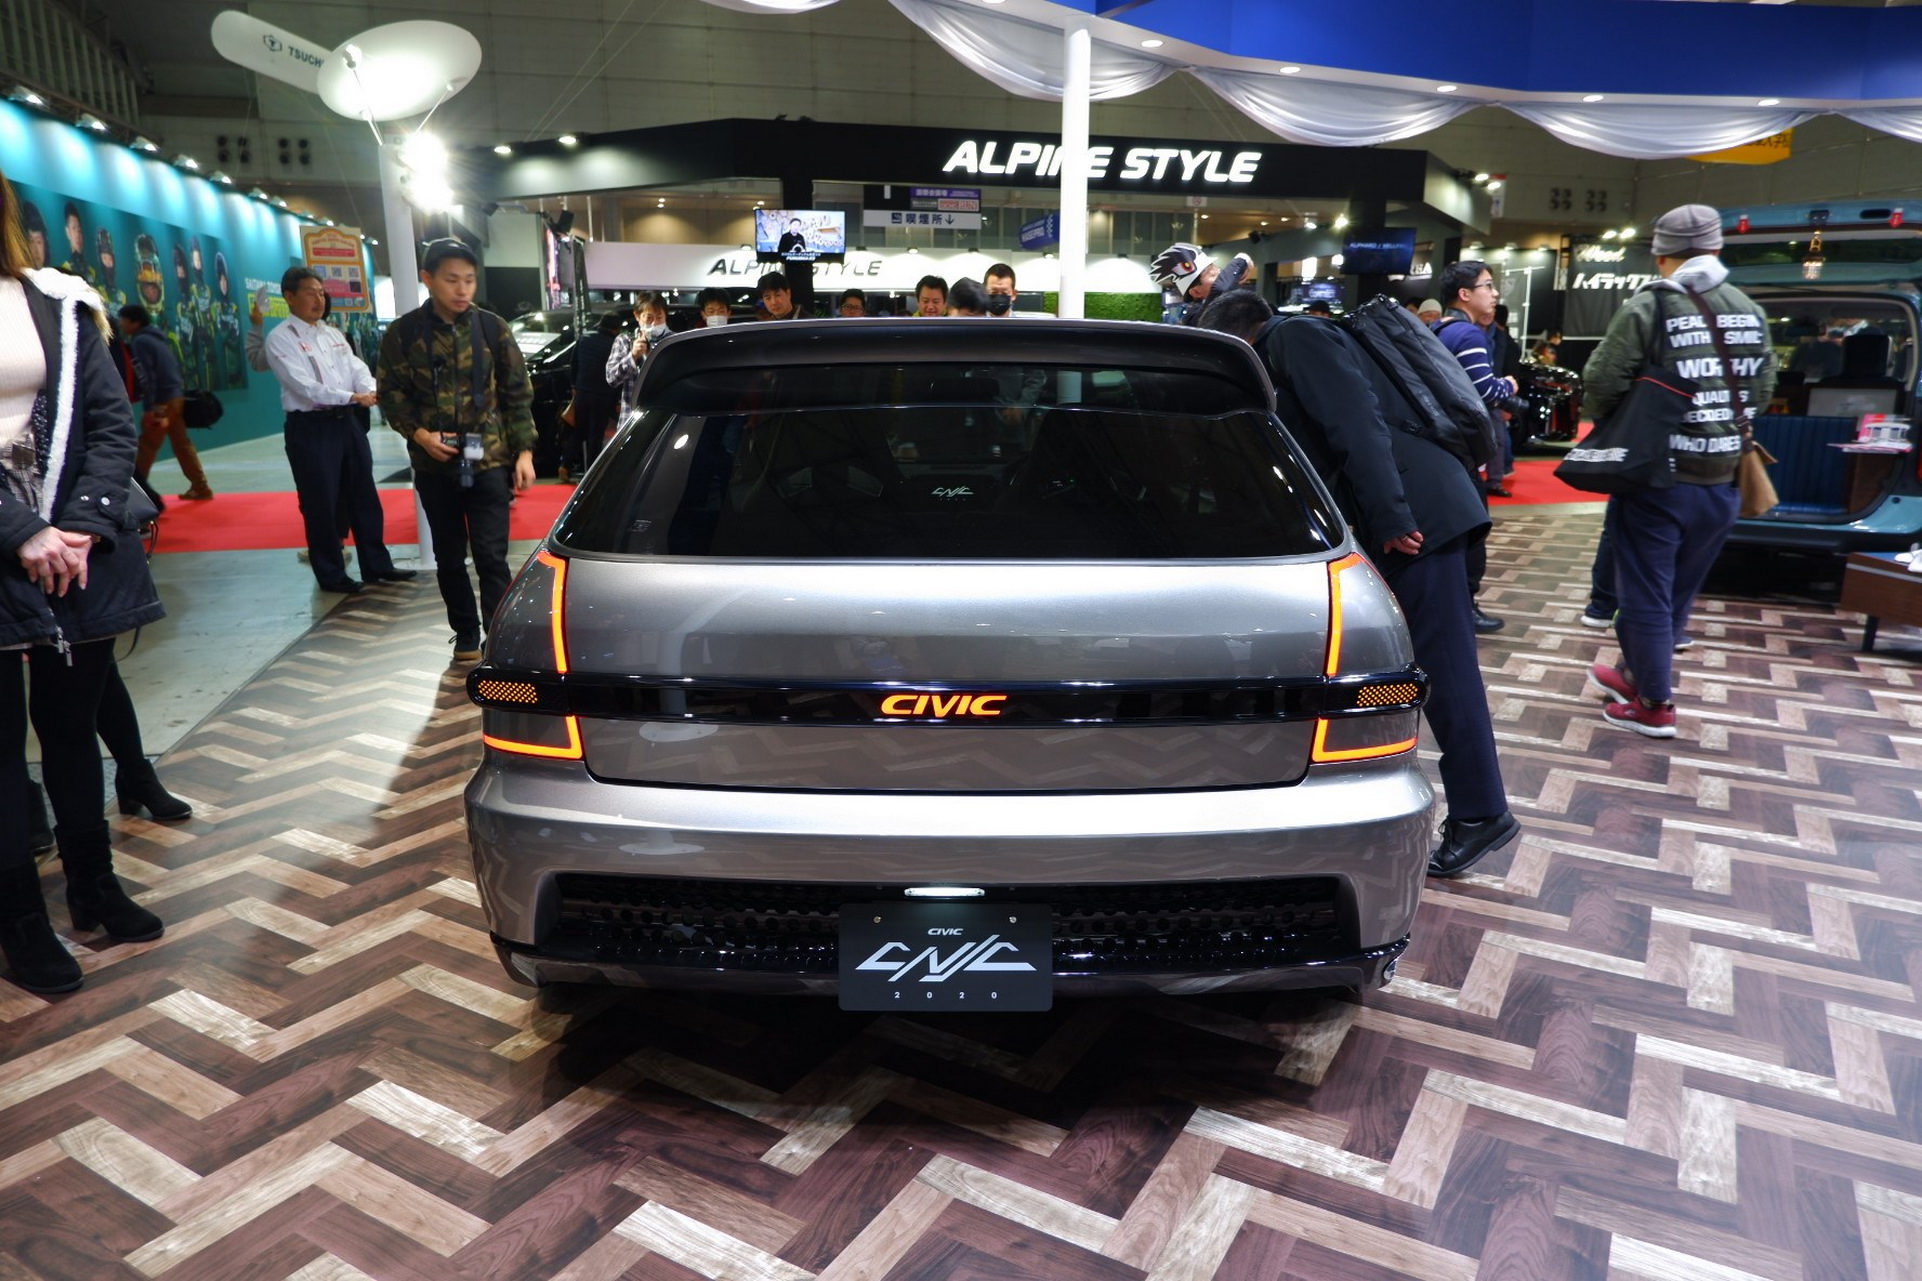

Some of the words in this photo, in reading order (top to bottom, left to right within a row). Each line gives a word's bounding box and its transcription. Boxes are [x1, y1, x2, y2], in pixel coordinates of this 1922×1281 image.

[288, 45, 325, 68] TSUCH
[1119, 147, 1262, 183] STYLE
[906, 212, 943, 225] 喫煙所
[1669, 331, 1712, 348] WITH
[1669, 434, 1707, 453] WHO
[880, 694, 1008, 718] CIVIC
[927, 927, 964, 936] CIVIC
